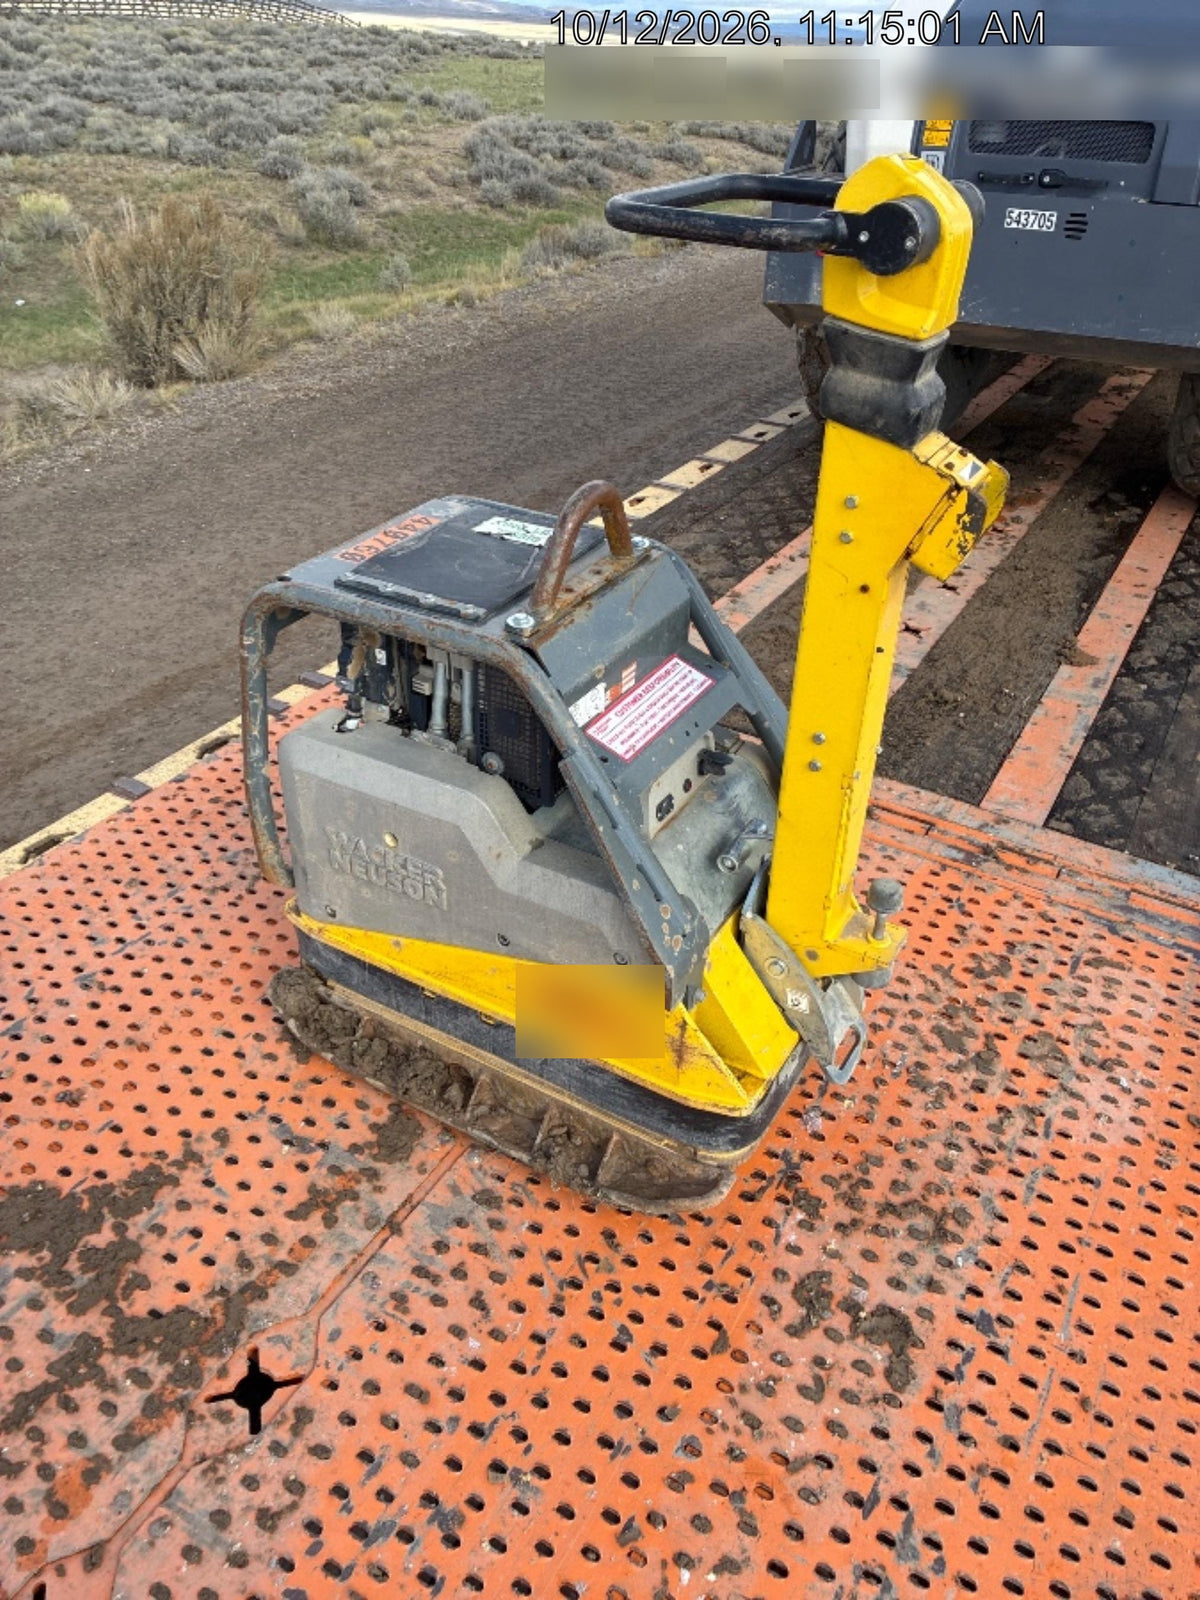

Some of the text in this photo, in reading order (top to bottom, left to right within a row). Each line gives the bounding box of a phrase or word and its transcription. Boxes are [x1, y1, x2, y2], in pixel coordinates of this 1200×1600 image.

[1005, 208, 1056, 231] 543705
[324, 826, 446, 890] WACKER
[327, 848, 449, 911] NEUSON
